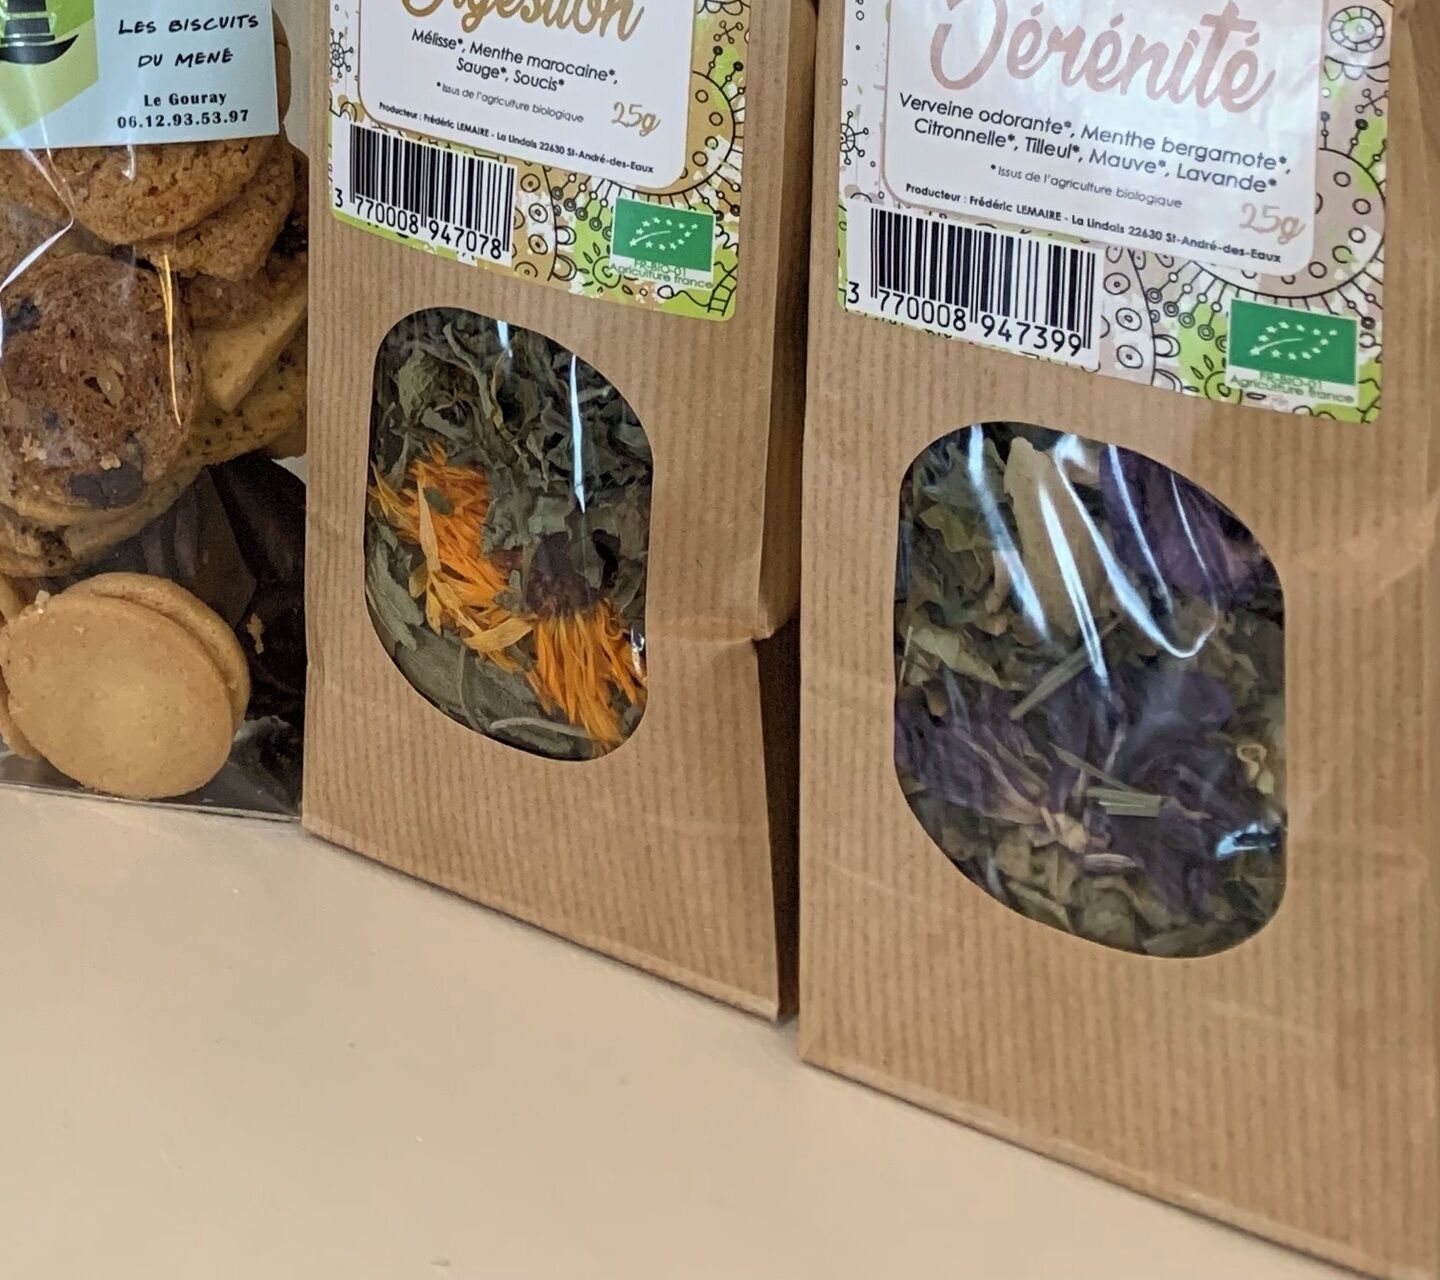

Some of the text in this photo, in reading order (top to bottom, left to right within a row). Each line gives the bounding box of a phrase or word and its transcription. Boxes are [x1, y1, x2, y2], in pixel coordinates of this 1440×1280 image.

[118, 14, 259, 35] LES BISCUITS
[138, 54, 163, 68] DU
[470, 42, 523, 65] Menthe
[144, 92, 227, 107] Le Gouray
[117, 109, 249, 129] 06.12.93.53.97
[610, 101, 661, 137] 25g
[899, 92, 973, 119] Verveine
[1081, 124, 1156, 150] Menthe
[1025, 171, 1041, 183] de
[1044, 175, 1112, 196] l'agriculture
[1116, 189, 1183, 208] biologique
[335, 188, 502, 260] 3 770008 947078
[905, 183, 1281, 262] Producteur Frédéric LEMAIRE La Lindais 22630 St-André-des-Eaux
[1239, 202, 1306, 245] 25g
[847, 281, 1082, 357] 3 770008 947399
